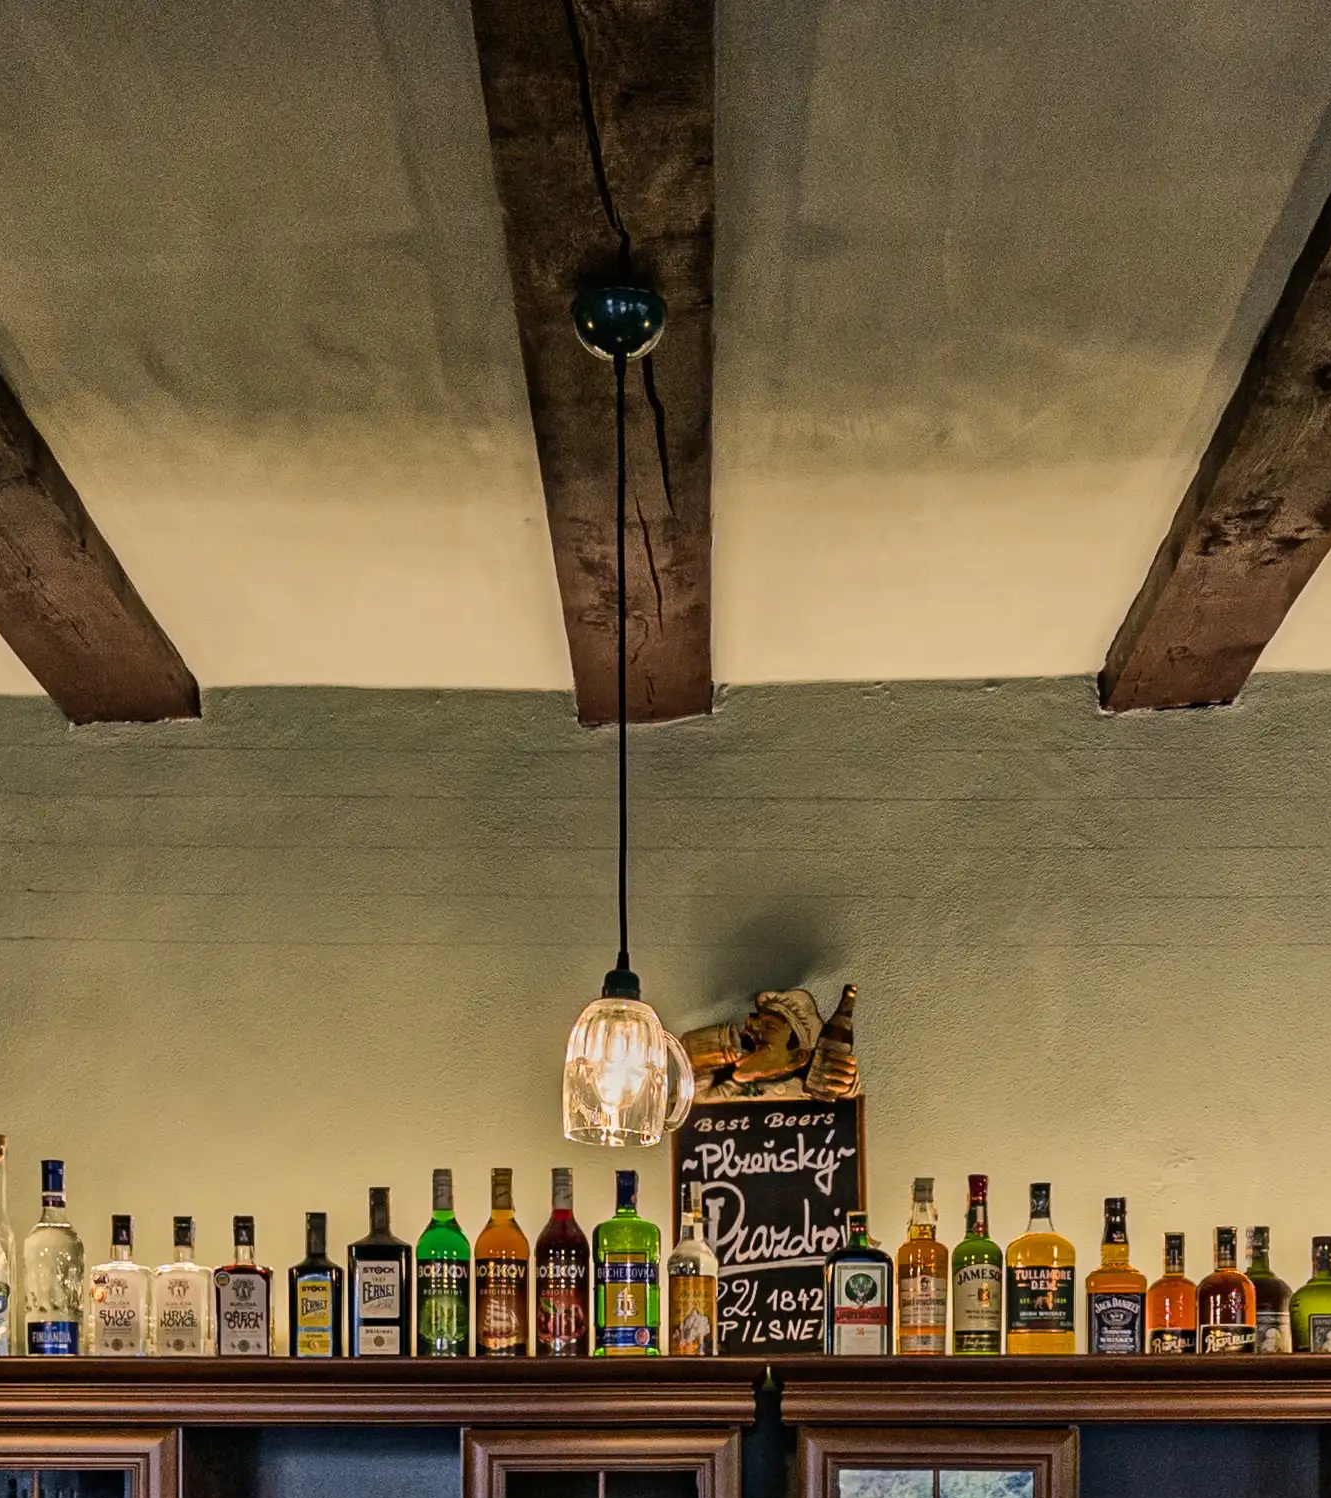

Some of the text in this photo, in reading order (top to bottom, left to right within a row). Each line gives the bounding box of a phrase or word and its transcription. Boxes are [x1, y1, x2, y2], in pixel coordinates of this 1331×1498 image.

[694, 1112, 835, 1132] Best Beers
[363, 1267, 395, 1275] STOCK
[1014, 1269, 1072, 1281] TULLAMORE
[362, 1282, 395, 1305] FERNET
[766, 1287, 824, 1312] 1842
[99, 1309, 136, 1320] SLIVO
[163, 1308, 194, 1320] HRUŠ
[224, 1310, 264, 1322] OŘECH
[103, 1317, 132, 1327] VICE
[160, 1317, 198, 1328] KOVICE
[228, 1319, 261, 1330] OVKA
[718, 1318, 824, 1342] PILSNE
[32, 1331, 72, 1344] FINLANDIA
